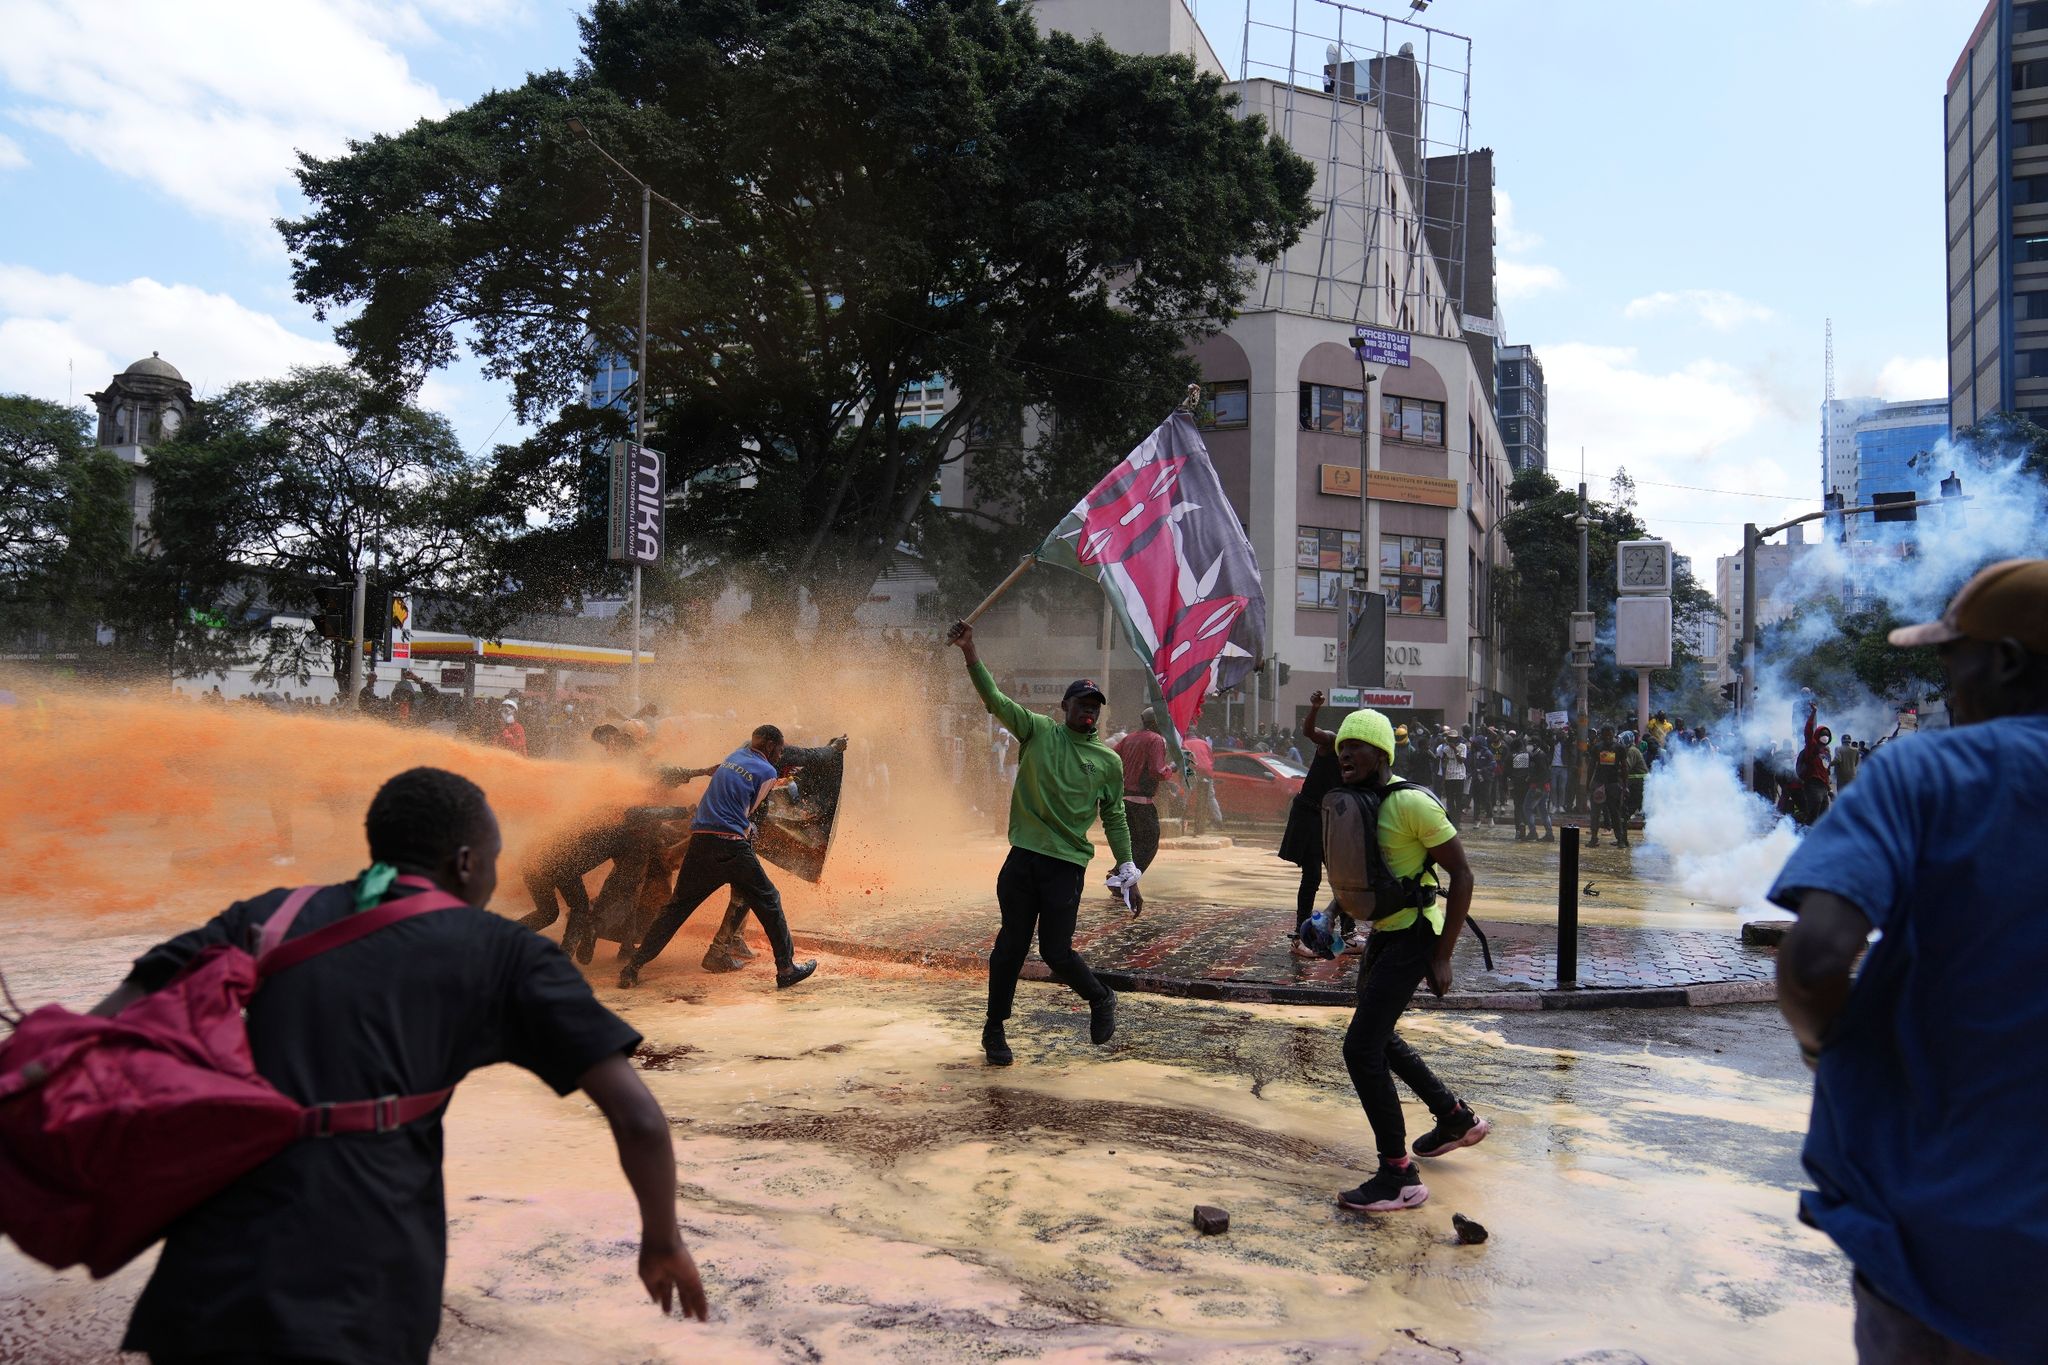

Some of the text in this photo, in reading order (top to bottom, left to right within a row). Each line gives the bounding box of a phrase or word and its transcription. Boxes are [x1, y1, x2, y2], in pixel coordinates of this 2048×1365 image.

[1358, 328, 1409, 344] OFFICES TO LET
[1378, 341, 1391, 349] 320
[1424, 480, 1457, 489] MANAGEMENT
[629, 471, 637, 523] Wonderful
[637, 447, 660, 561] MIKA
[629, 525, 637, 556] World
